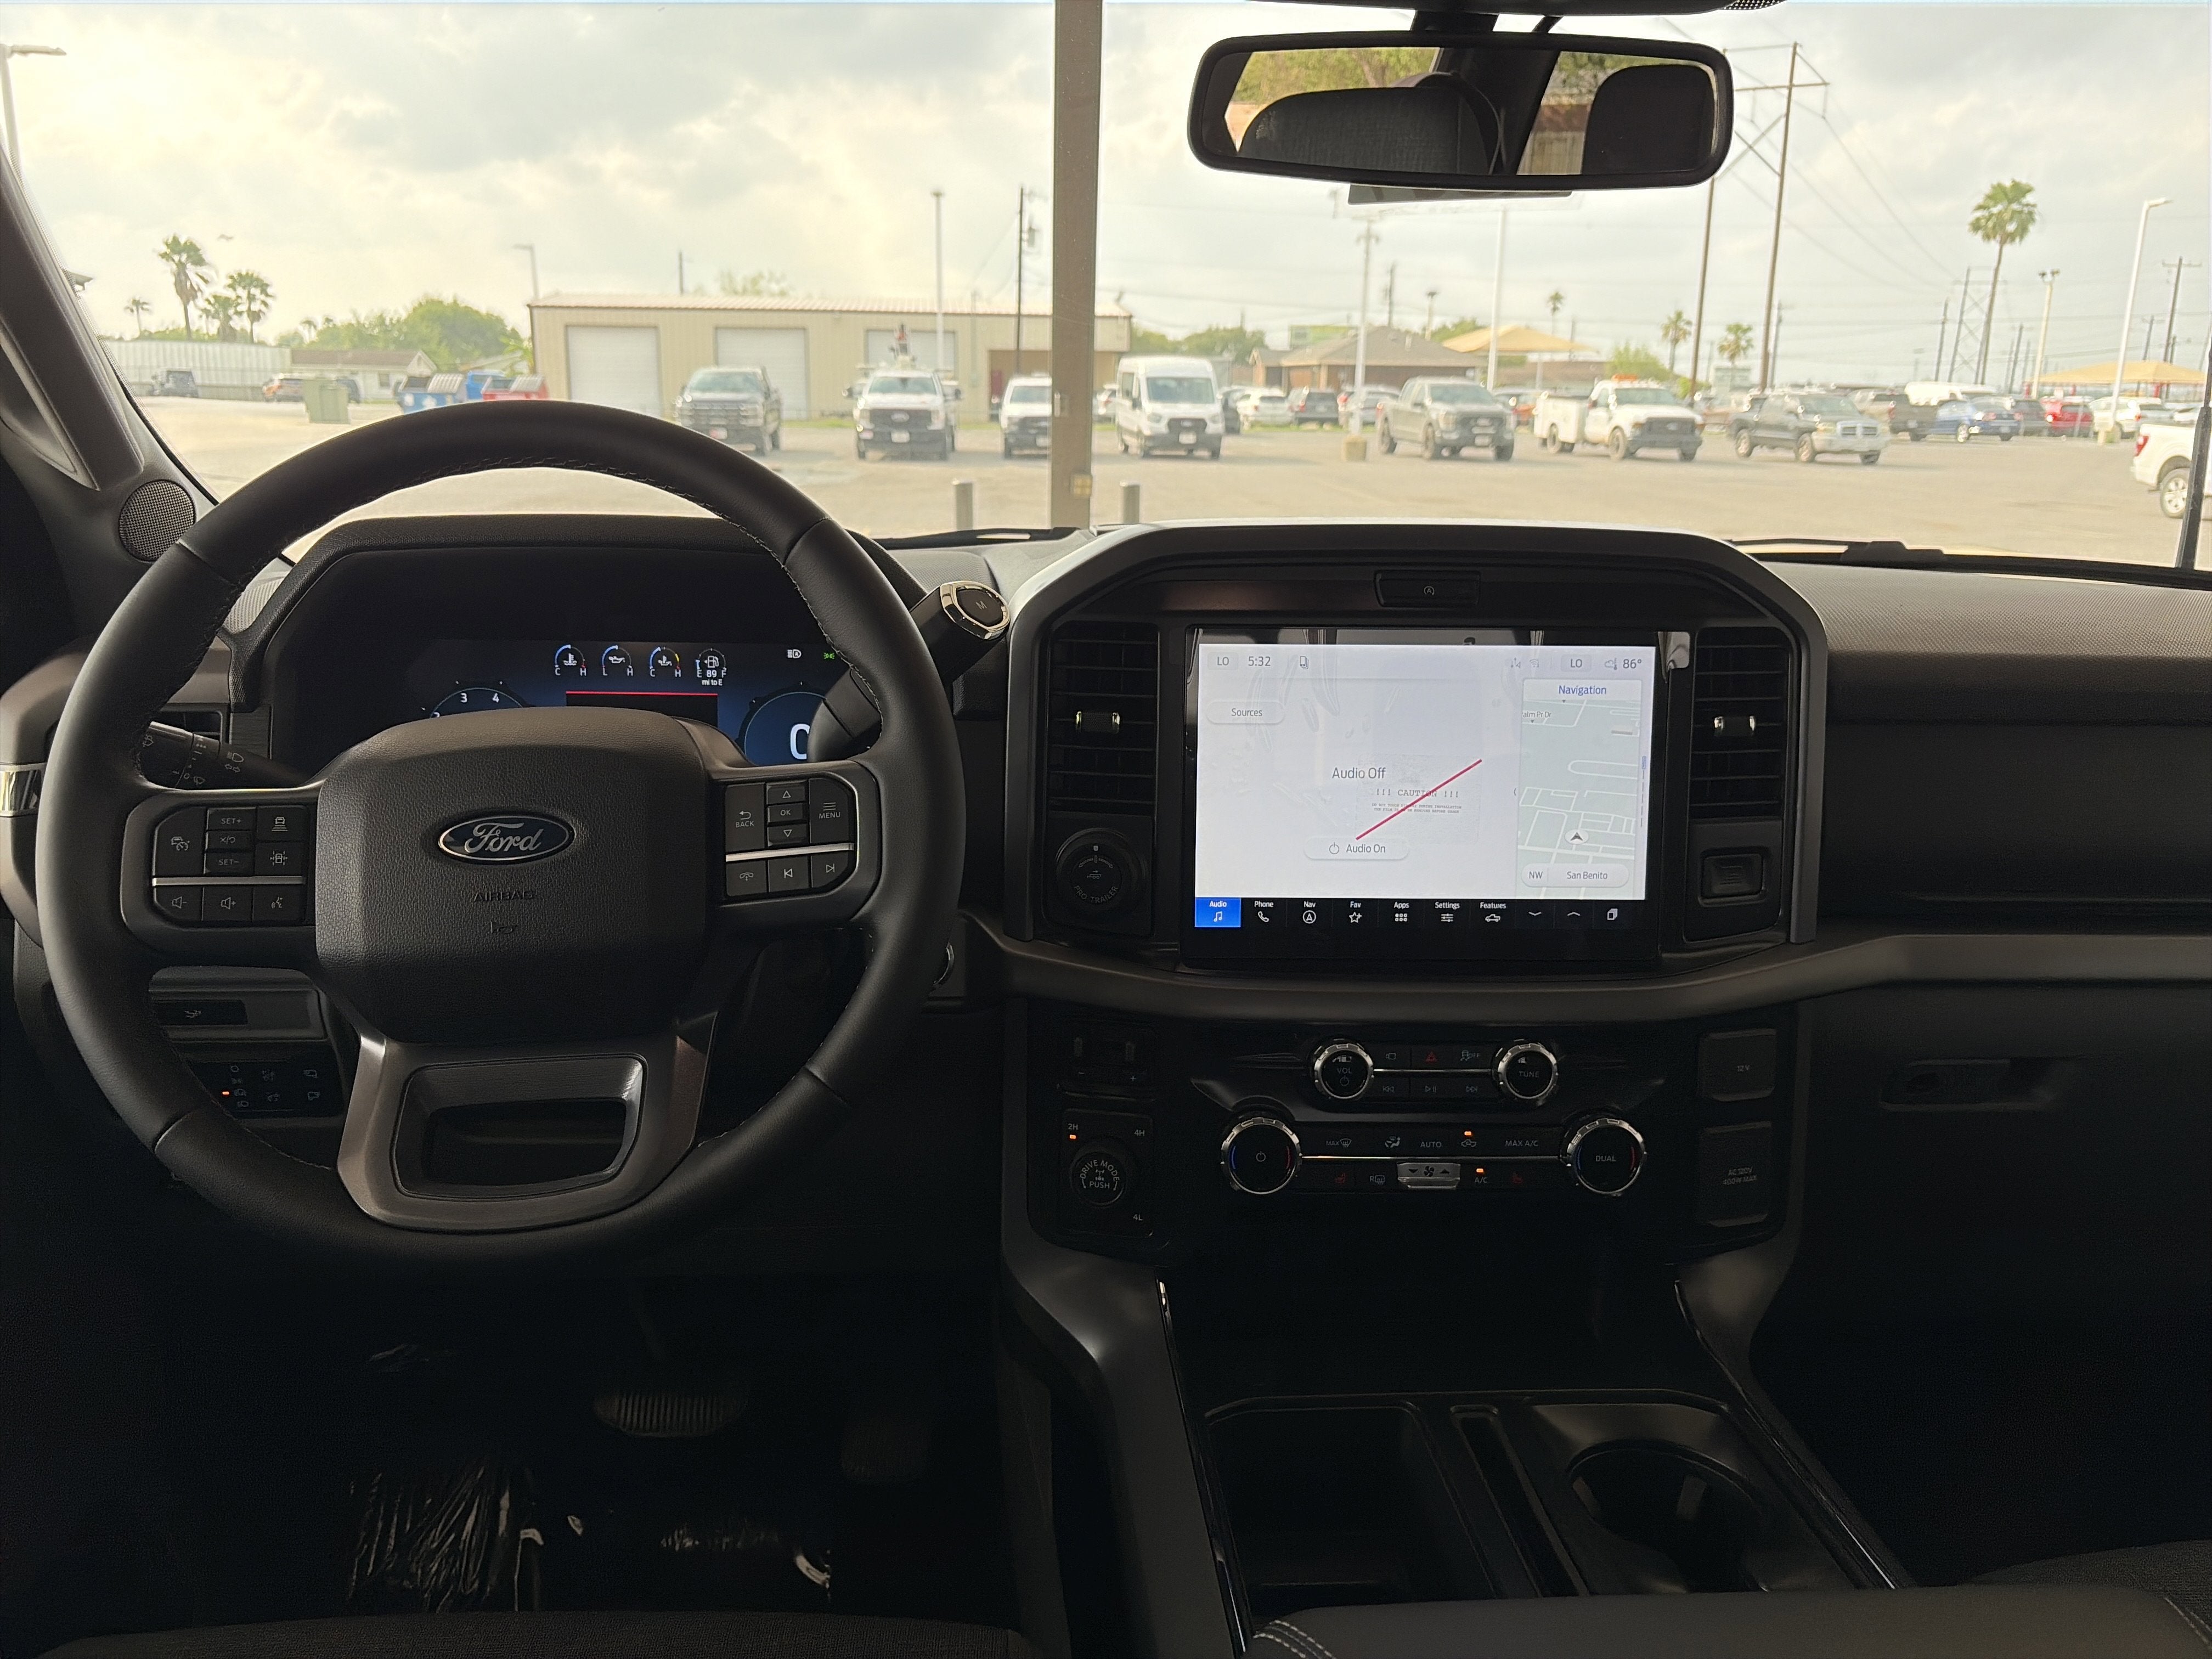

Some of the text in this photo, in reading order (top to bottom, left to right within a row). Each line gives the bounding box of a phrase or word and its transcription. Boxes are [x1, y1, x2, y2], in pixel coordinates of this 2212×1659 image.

[975, 601, 988, 610] M
[1217, 656, 1229, 666] LO
[1248, 656, 1271, 667] 5:32
[1570, 658, 1582, 668] LO
[1623, 658, 1642, 669] 86°
[554, 667, 561, 676] C
[580, 668, 586, 676] H
[602, 667, 608, 676] L
[627, 668, 633, 676] H
[650, 669, 656, 678] C
[675, 669, 681, 678] H
[696, 670, 702, 678] E
[706, 669, 717, 678] 89
[721, 670, 727, 678] F
[1558, 685, 1607, 696] Navigation
[460, 692, 467, 703] 3
[492, 692, 500, 703] 4
[1231, 708, 1263, 716] Sources
[1332, 767, 1386, 779] Audio Off
[819, 811, 841, 820] MENU
[735, 820, 754, 828] BACK
[464, 822, 545, 854] Ford
[1346, 843, 1386, 853] Audio On
[1528, 871, 1608, 879] NW San Benito
[473, 889, 535, 902] AIRBAG
[1074, 885, 1118, 904] PRO TRAILER
[1524, 1139, 1538, 1147] A/C
[1079, 1159, 1120, 1181] DRIVE MODE
[1089, 1181, 1110, 1189] PUSH
